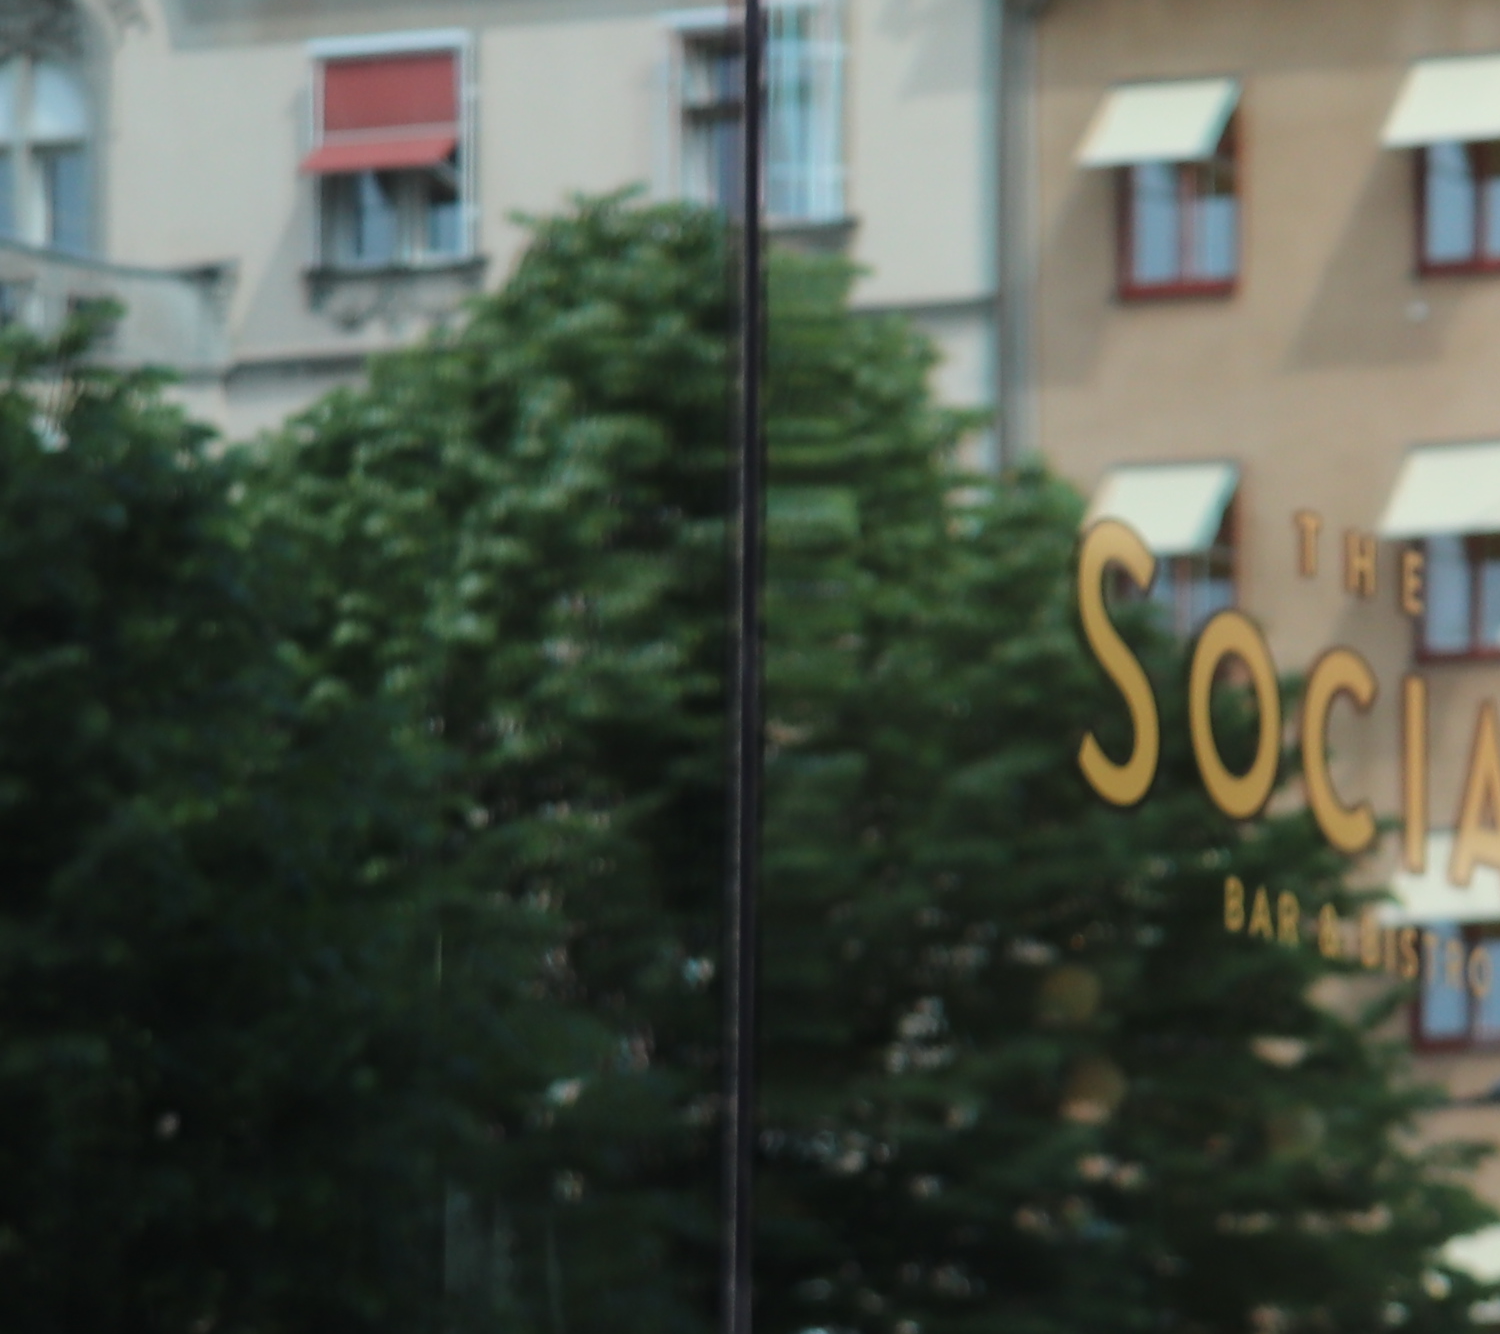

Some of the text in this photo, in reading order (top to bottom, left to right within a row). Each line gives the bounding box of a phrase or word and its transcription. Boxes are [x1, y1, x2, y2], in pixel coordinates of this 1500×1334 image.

[1293, 512, 1424, 614] THE
[1223, 875, 1494, 999] BAR & BISTRO
